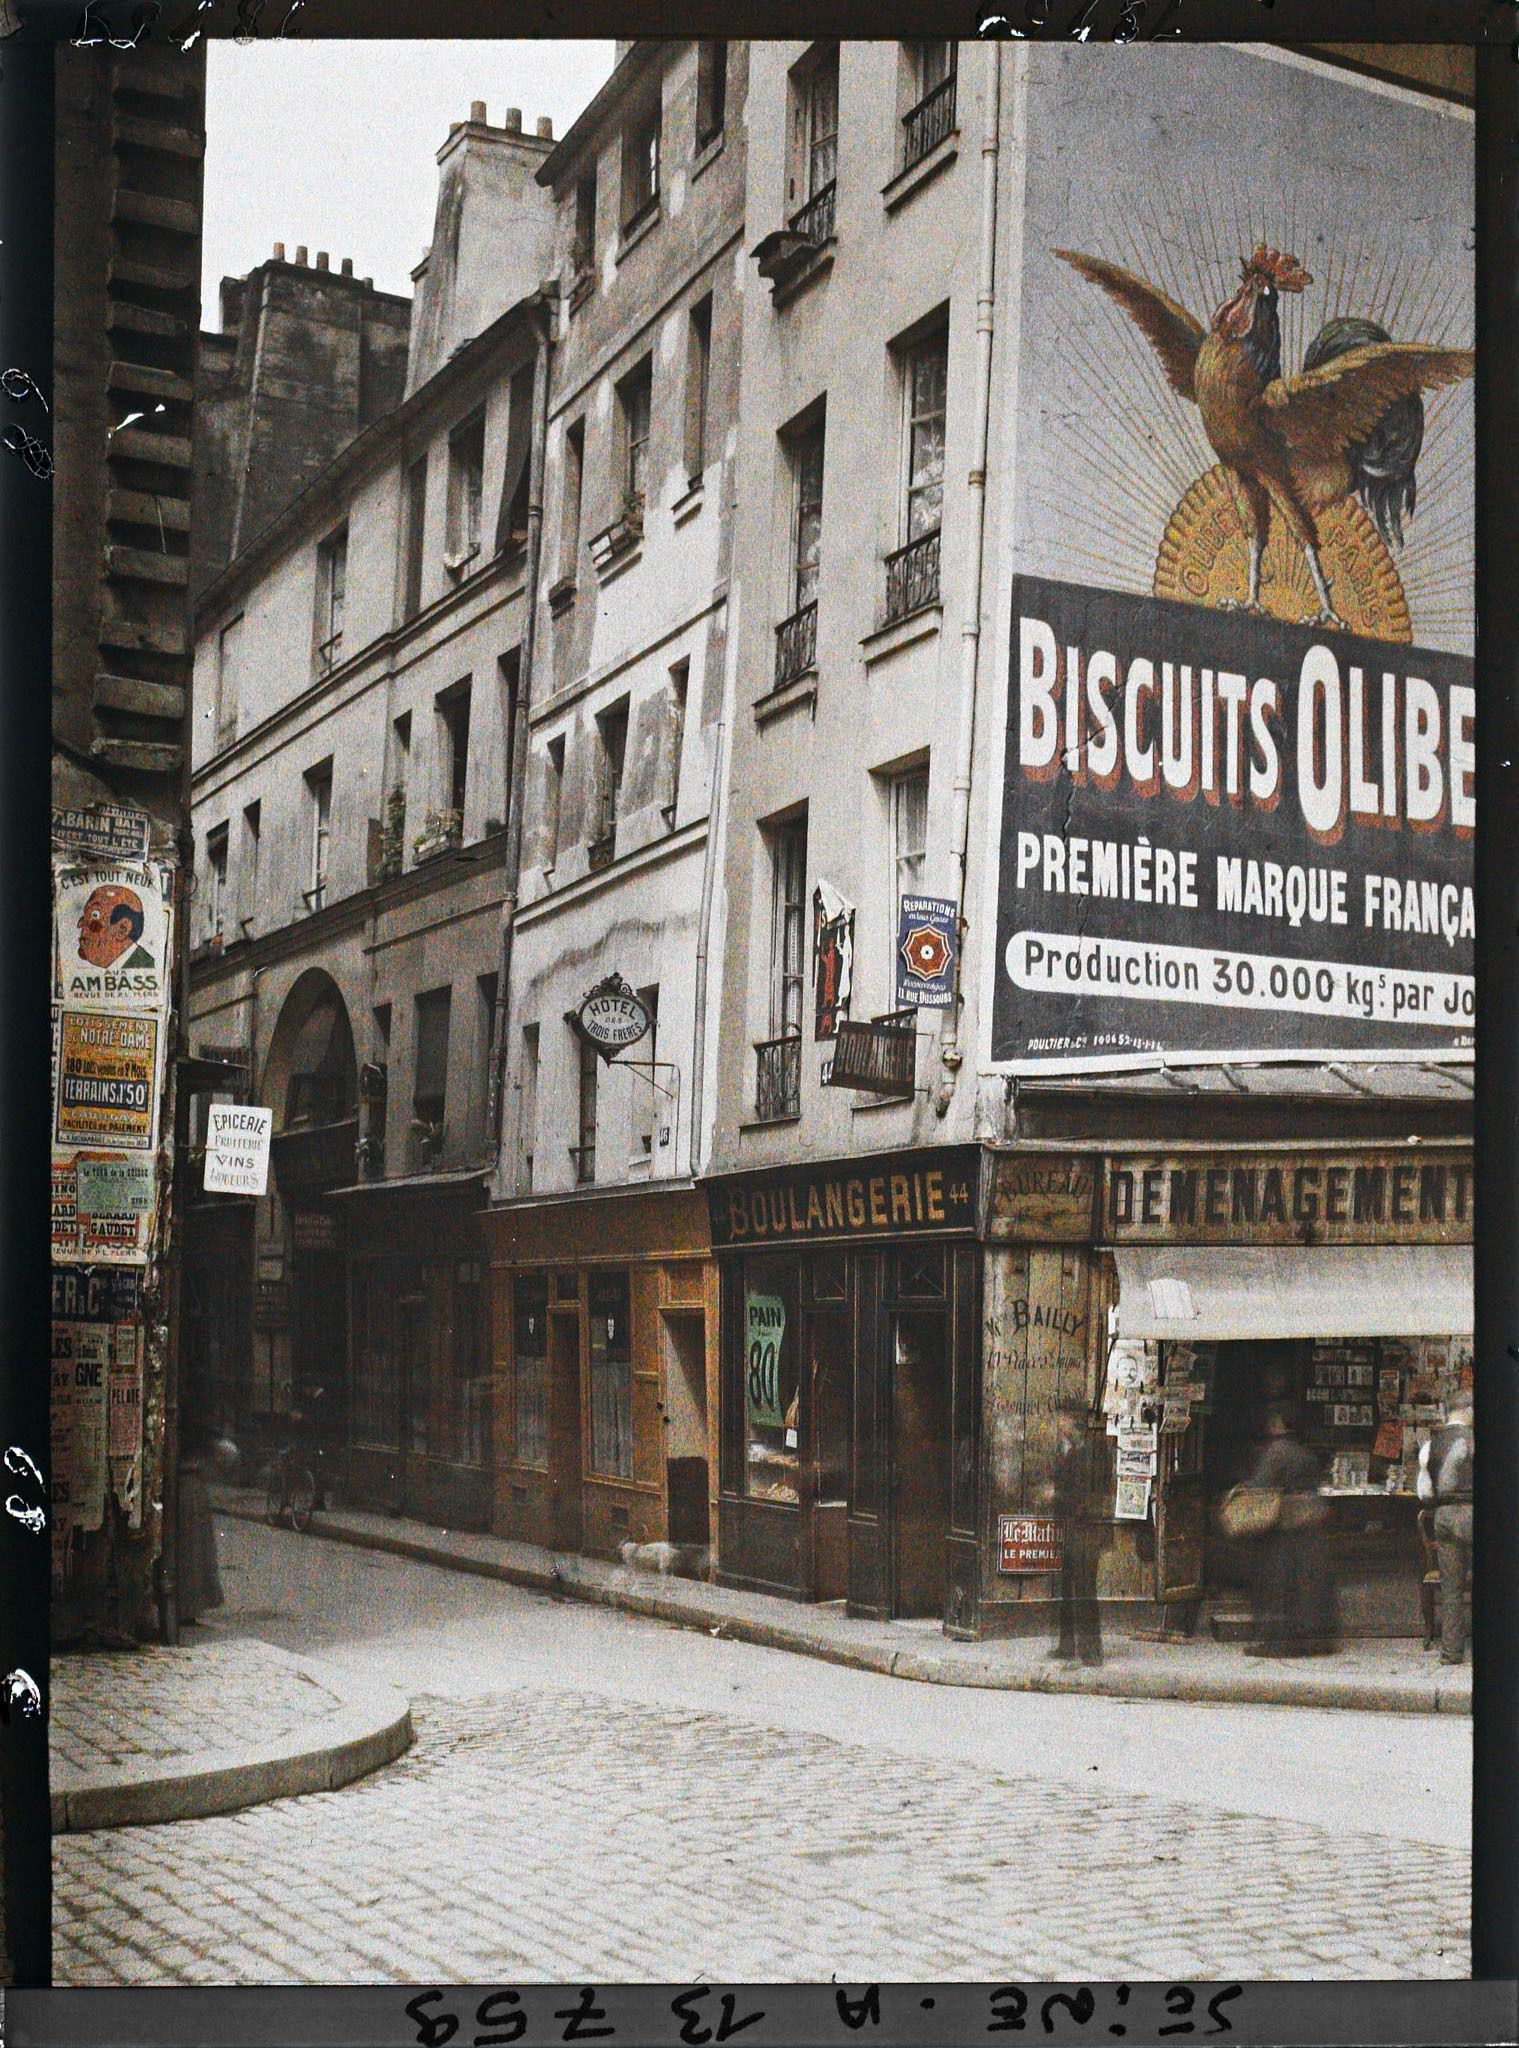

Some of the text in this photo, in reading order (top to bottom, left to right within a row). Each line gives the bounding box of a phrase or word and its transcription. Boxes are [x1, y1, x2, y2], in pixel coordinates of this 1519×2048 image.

[1019, 616, 1475, 836] BISCUITS OLIBE
[61, 872, 89, 890] C'EST
[94, 870, 120, 882] TOUT
[1017, 831, 1475, 946] PREMIÈRE MARQUE FRANÇA
[70, 975, 157, 991] AMBASS
[1025, 939, 1199, 990] Production
[1212, 958, 1334, 1004] 30.000
[1393, 983, 1434, 1018] par
[1444, 982, 1475, 1016] Jo
[898, 986, 905, 999] 11
[906, 989, 918, 1003] RUE
[589, 999, 637, 1020] HOTEL
[80, 1029, 116, 1045] NOTRE
[120, 1032, 151, 1048] DAME
[587, 1020, 643, 1041] TROIS FRERES
[1027, 1037, 1070, 1050] POULTIER
[65, 1079, 116, 1103] TERRAINS
[109, 1123, 146, 1134] PAIEMENT
[213, 1114, 267, 1135] EPICERIE
[216, 1154, 255, 1169] VINS
[210, 1167, 258, 1189] LIQUEURS
[1110, 1165, 1475, 1224] DEMENAGEMENT
[730, 1171, 969, 1240] BOULANGERIE 44
[91, 1223, 135, 1236] GAUDET
[749, 1306, 782, 1327] PAIN
[1011, 1299, 1084, 1337] BAILLY
[75, 1363, 103, 1387] GNE
[749, 1340, 775, 1413] 80
[1003, 1521, 1021, 1542] Le
[1004, 1550, 1016, 1559] LE
[671, 1987, 765, 2045] 13
[836, 1986, 880, 2029] A
